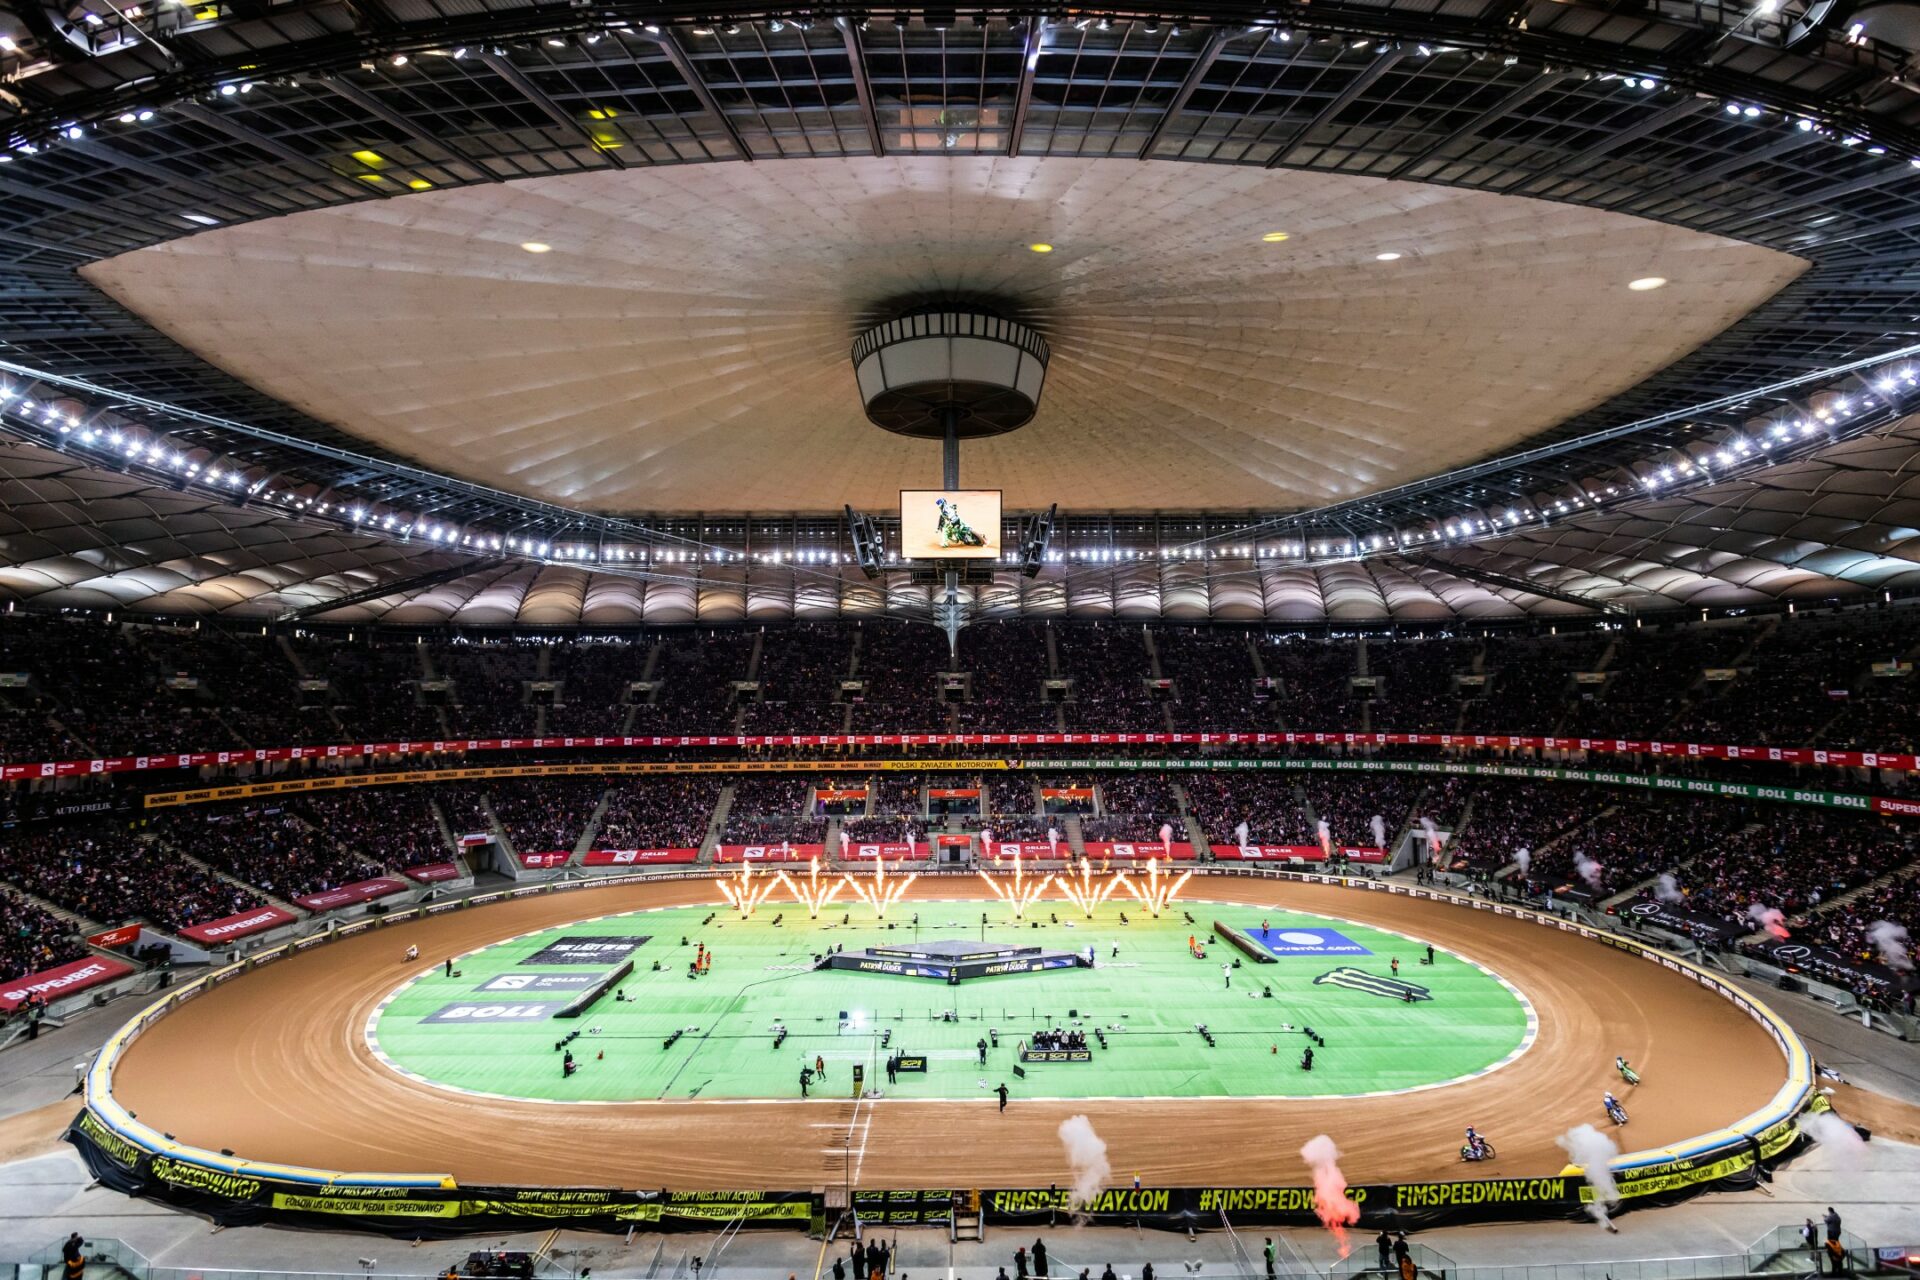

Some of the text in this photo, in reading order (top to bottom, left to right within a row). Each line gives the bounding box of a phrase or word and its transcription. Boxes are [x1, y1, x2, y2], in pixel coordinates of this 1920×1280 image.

[955, 761, 998, 769] MOTOROWY
[1390, 762, 1413, 770] BOLL
[1417, 763, 1440, 771] BOLL
[1445, 764, 1469, 773] BOLL
[1475, 765, 1499, 774] BOLL
[1504, 767, 1529, 776] BOLL
[1533, 769, 1558, 778] BOLL
[1565, 771, 1590, 780] BOLL
[1595, 773, 1620, 783] BOLL
[1625, 776, 1649, 786] BOLL
[1656, 778, 1683, 789] BOLL
[1687, 781, 1715, 792] BOLL
[1720, 784, 1749, 796] BOLL
[1757, 788, 1787, 799] BOLL
[1793, 791, 1826, 804] BOLL
[1833, 795, 1867, 808] BOLL
[55, 802, 112, 816] AUTO FRELIK
[1880, 800, 1920, 814] SUPER
[584, 878, 624, 888] events.com
[623, 875, 662, 883] events.com
[662, 872, 700, 880] events.com
[204, 911, 279, 936] SUPERBET
[439, 1005, 546, 1018] BOLL
[360, 1188, 377, 1197] ANY
[377, 1188, 409, 1198] ACTION!
[671, 1191, 697, 1201] DON'T
[697, 1191, 714, 1201] MISS
[715, 1191, 732, 1201] ANY
[855, 1191, 879, 1199] SGP
[889, 1191, 913, 1199] SGP
[923, 1190, 947, 1199] SGP
[1396, 1178, 1565, 1208] FIMSPEEDWAY.COM
[285, 1197, 312, 1209] FOLLOW
[313, 1200, 323, 1209] US
[324, 1200, 334, 1210] ON
[334, 1201, 361, 1211] SOCIAL
[362, 1202, 385, 1212] MEDIA
[1199, 1188, 1367, 1211] #FIMSPEEDWGP
[686, 1206, 701, 1216] THE
[701, 1206, 741, 1216] SPEEDWAY
[742, 1206, 795, 1217] APPLICATION!
[856, 1211, 879, 1220] SGP
[889, 1211, 914, 1220] SGP
[924, 1209, 948, 1219] SGP
